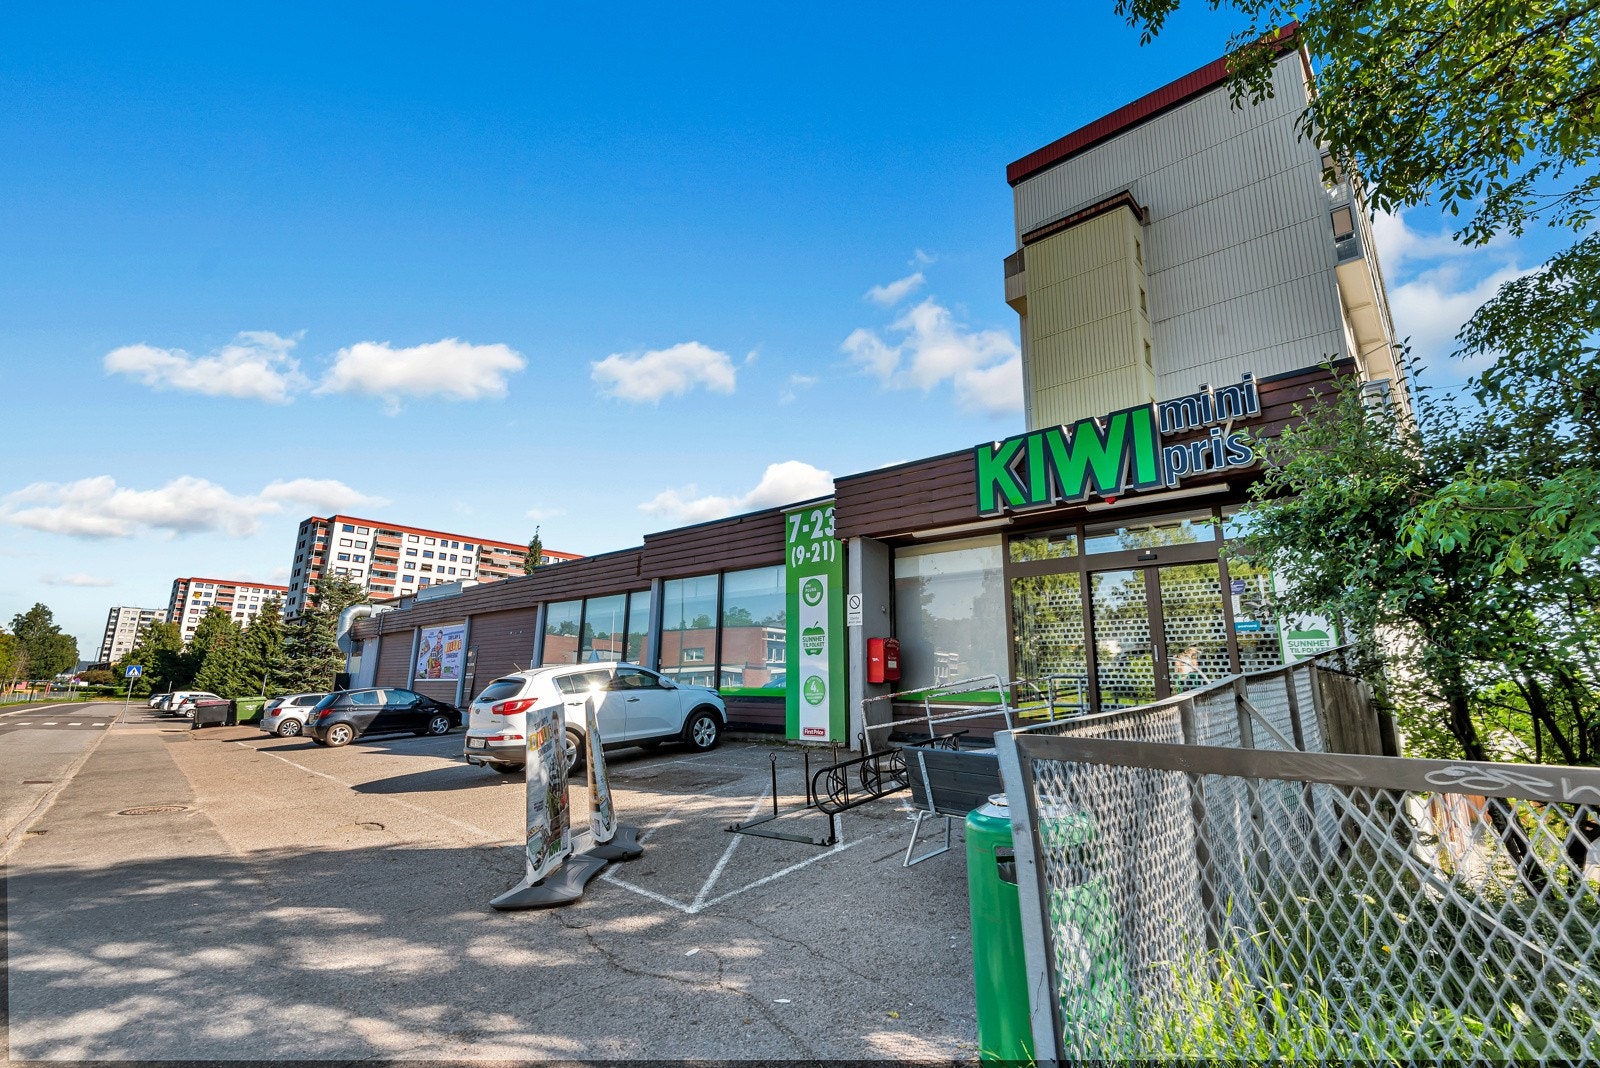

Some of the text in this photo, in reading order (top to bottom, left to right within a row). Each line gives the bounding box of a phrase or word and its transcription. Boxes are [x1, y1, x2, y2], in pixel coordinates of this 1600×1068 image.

[1158, 372, 1260, 434] mini
[975, 402, 1163, 516] KIWI
[1163, 427, 1256, 487] pris
[789, 506, 836, 543] 7-23
[791, 540, 835, 568] (9-21)
[1287, 640, 1330, 648] SUNNHET
